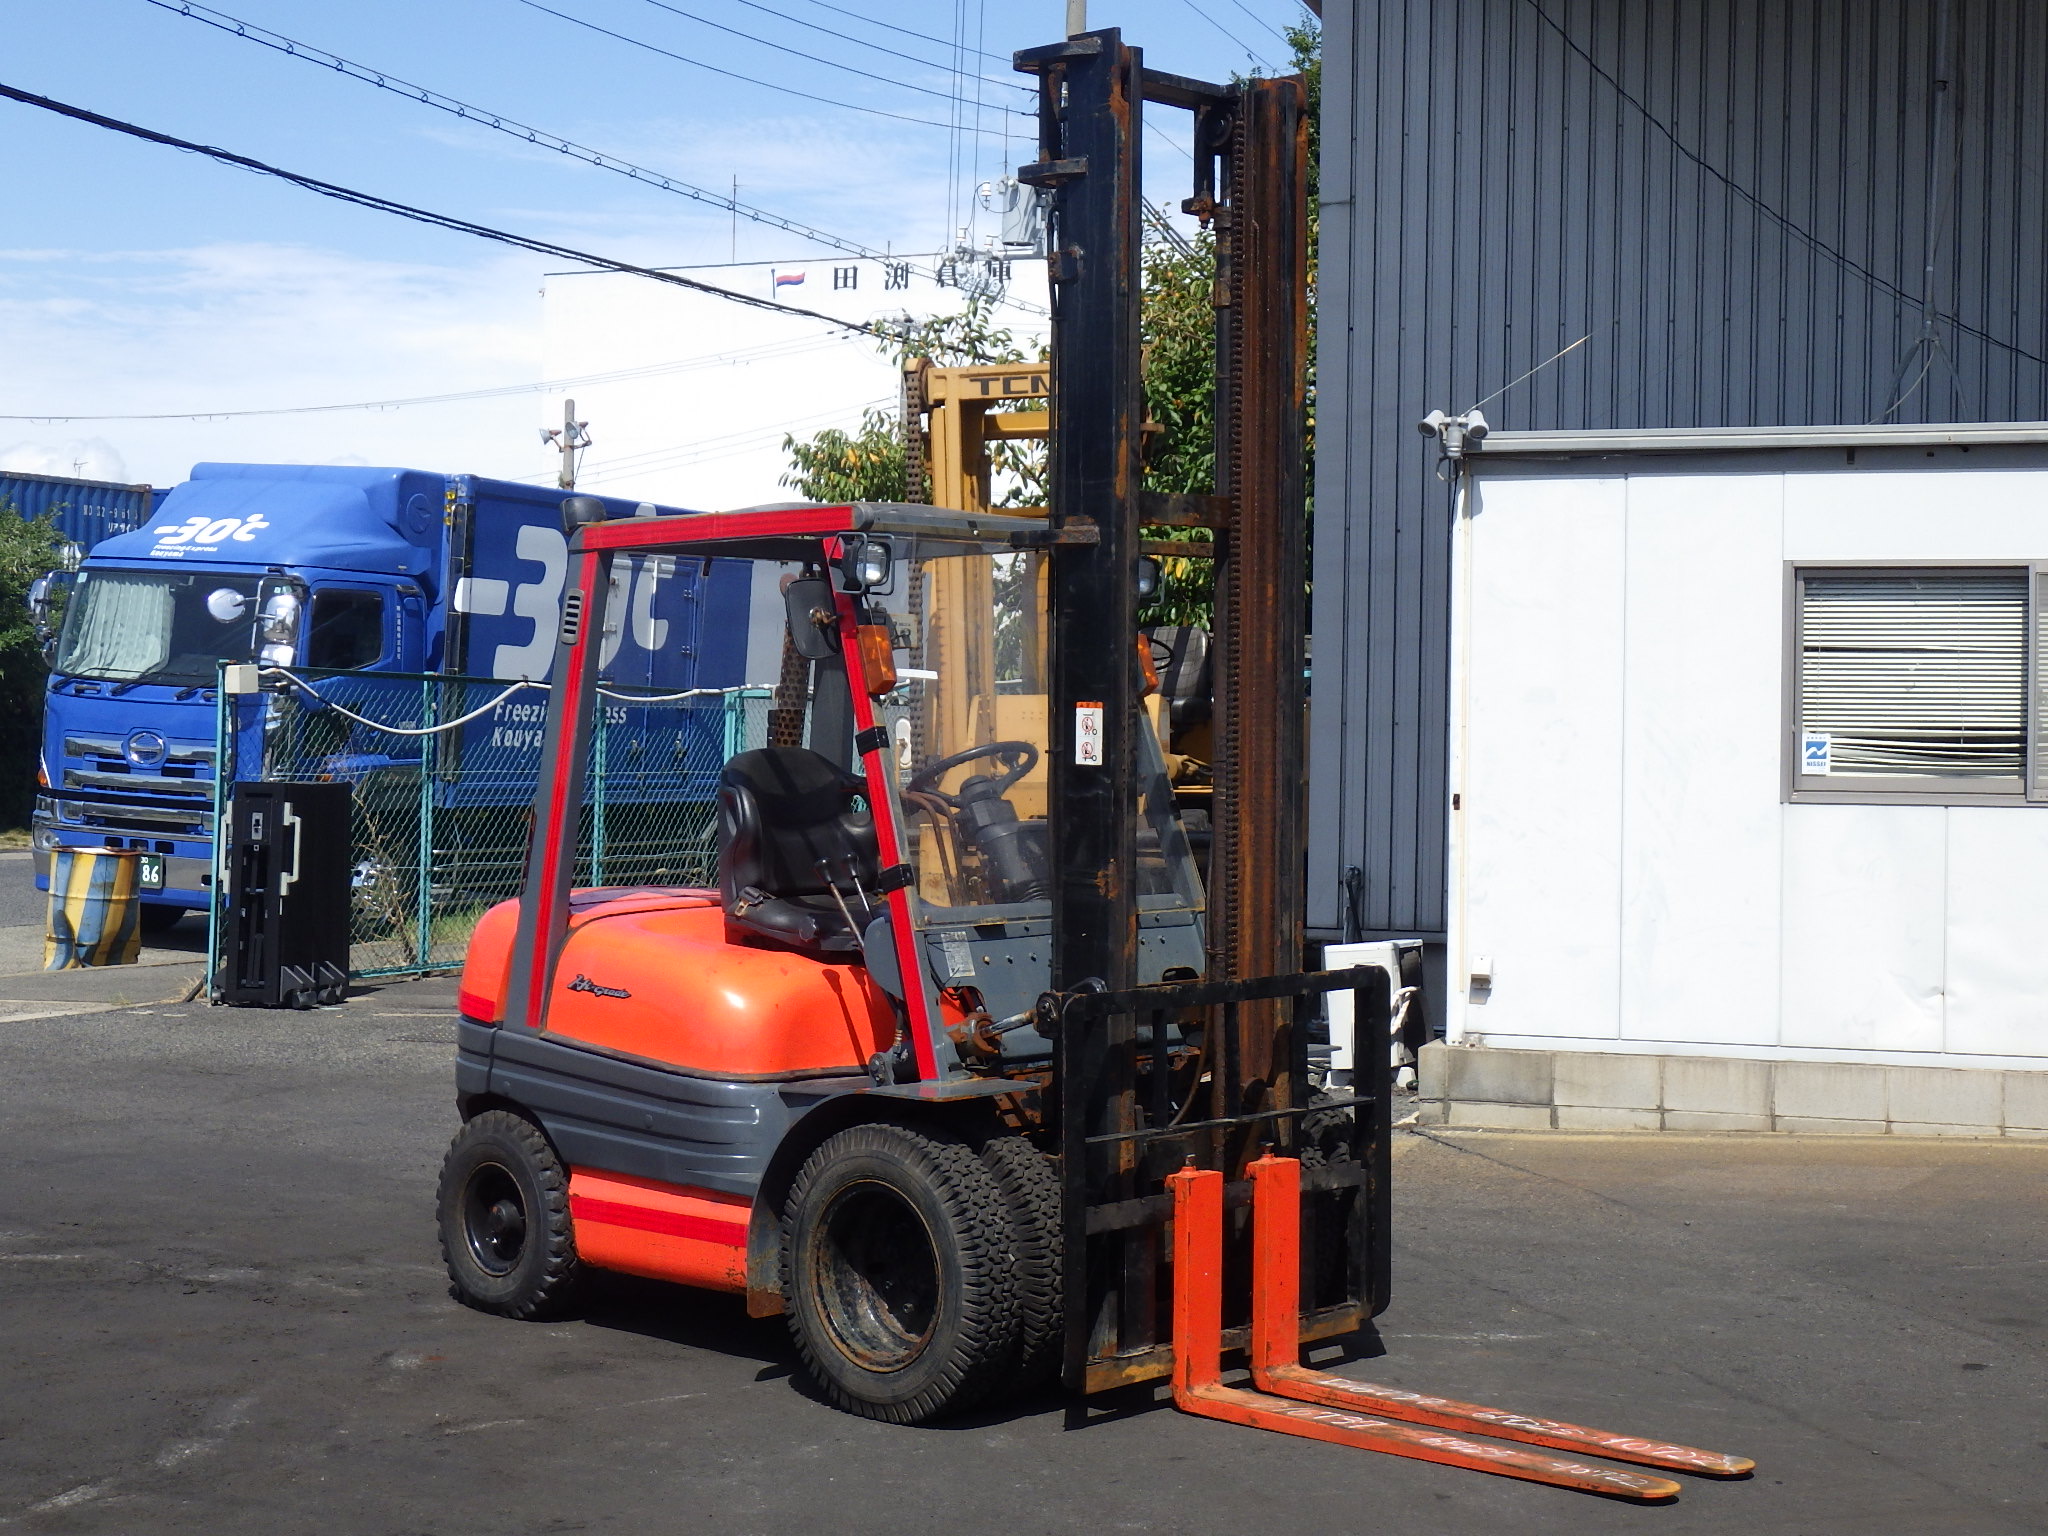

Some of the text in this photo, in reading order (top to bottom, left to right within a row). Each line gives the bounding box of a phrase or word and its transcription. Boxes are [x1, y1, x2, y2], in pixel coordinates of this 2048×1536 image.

[493, 700, 548, 721] Freezi
[491, 726, 543, 751] Kouya
[142, 864, 159, 883] 86
